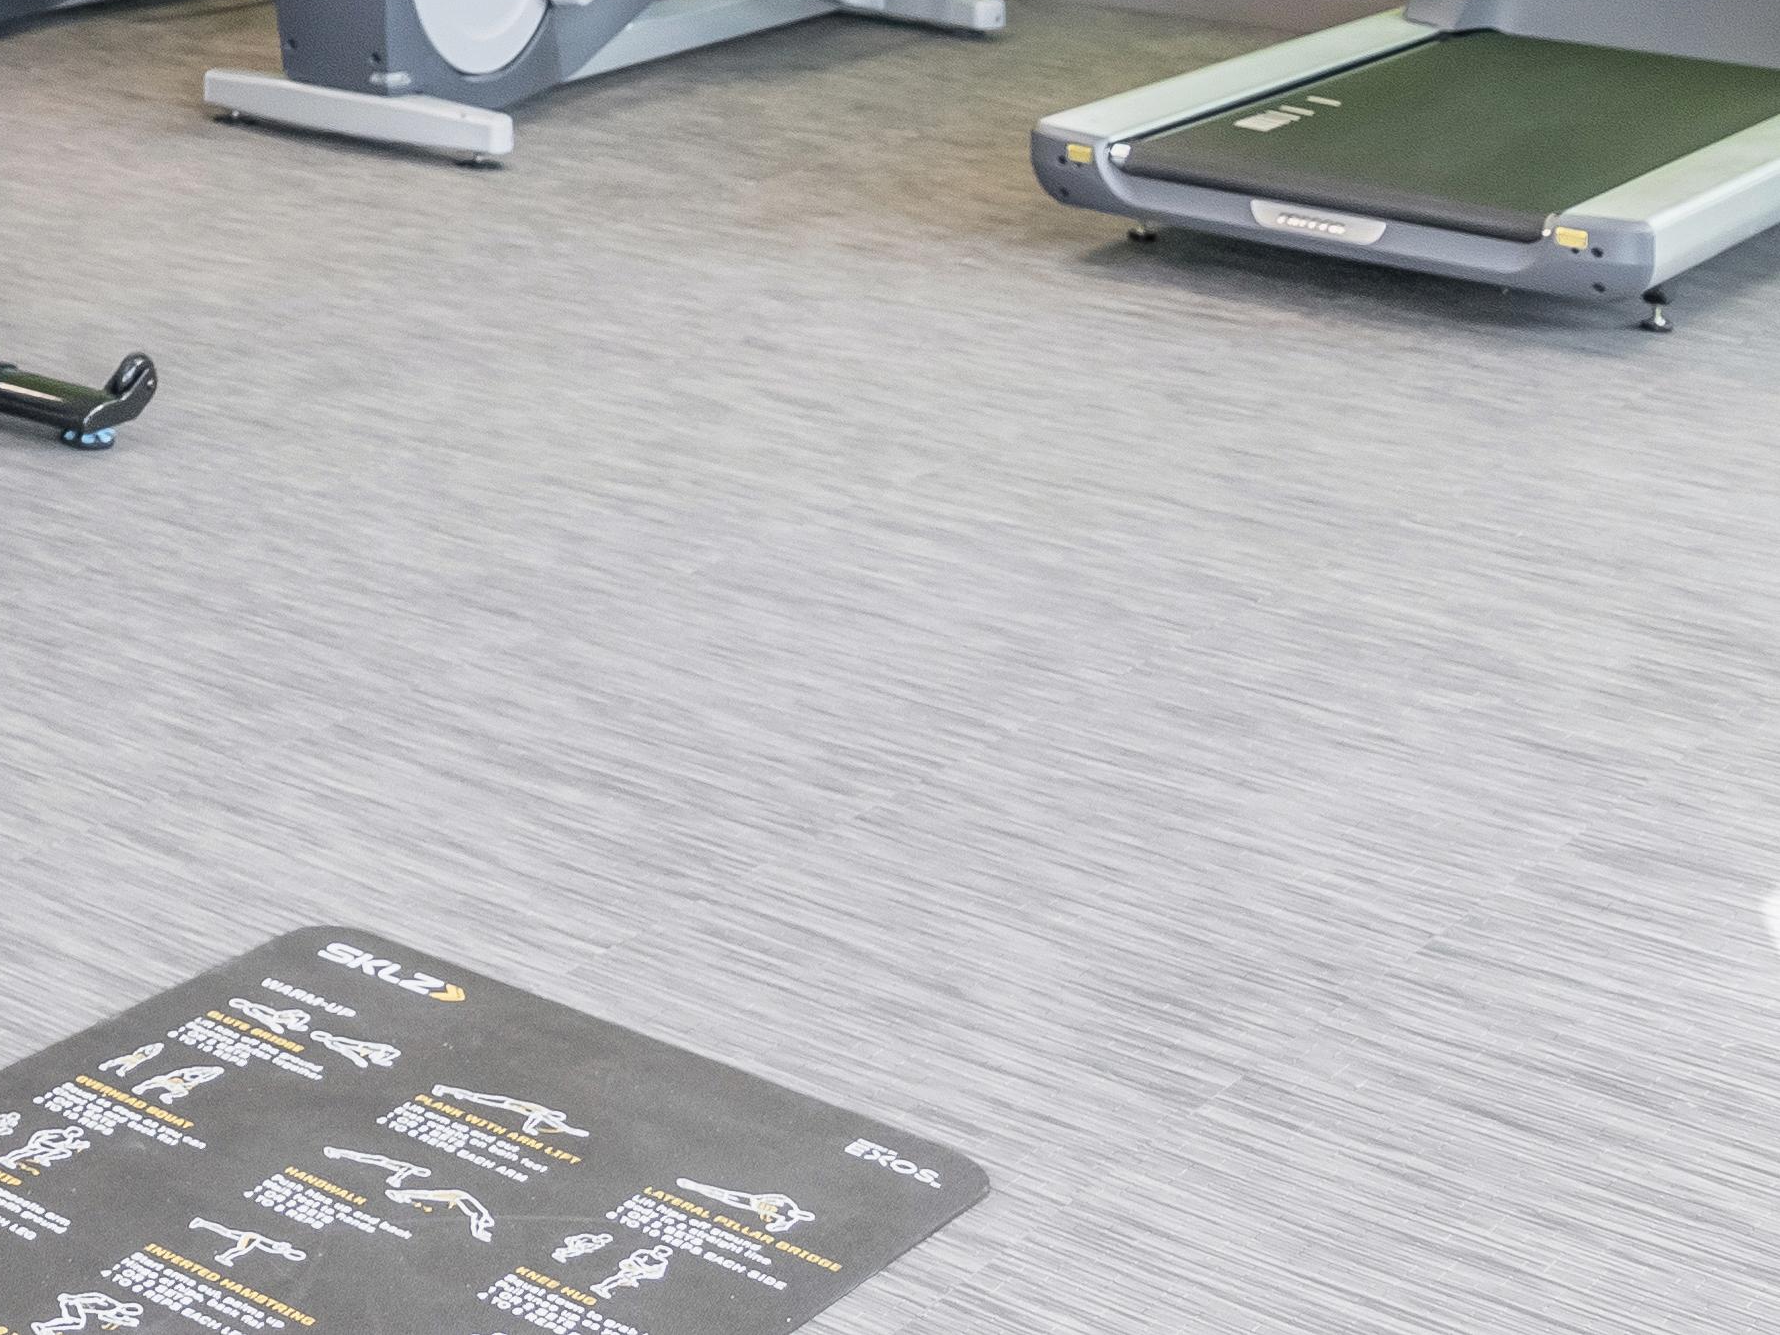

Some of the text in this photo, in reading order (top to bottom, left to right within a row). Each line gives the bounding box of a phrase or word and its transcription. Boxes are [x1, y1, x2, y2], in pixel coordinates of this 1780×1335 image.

[317, 942, 445, 995] SKLZ
[261, 977, 357, 1017] WARM-UP
[414, 1094, 465, 1118] PLANK
[465, 1114, 508, 1135] WITH
[506, 1132, 544, 1150] ARM
[544, 1146, 582, 1164] LIFT
[284, 1166, 368, 1205] HANDWALK
[643, 1186, 843, 1272] LATERAL PILLAR BRIDGE
[142, 1243, 316, 1326] INVERTED HAMSTRING
[515, 1266, 600, 1308] KNEE HUG
